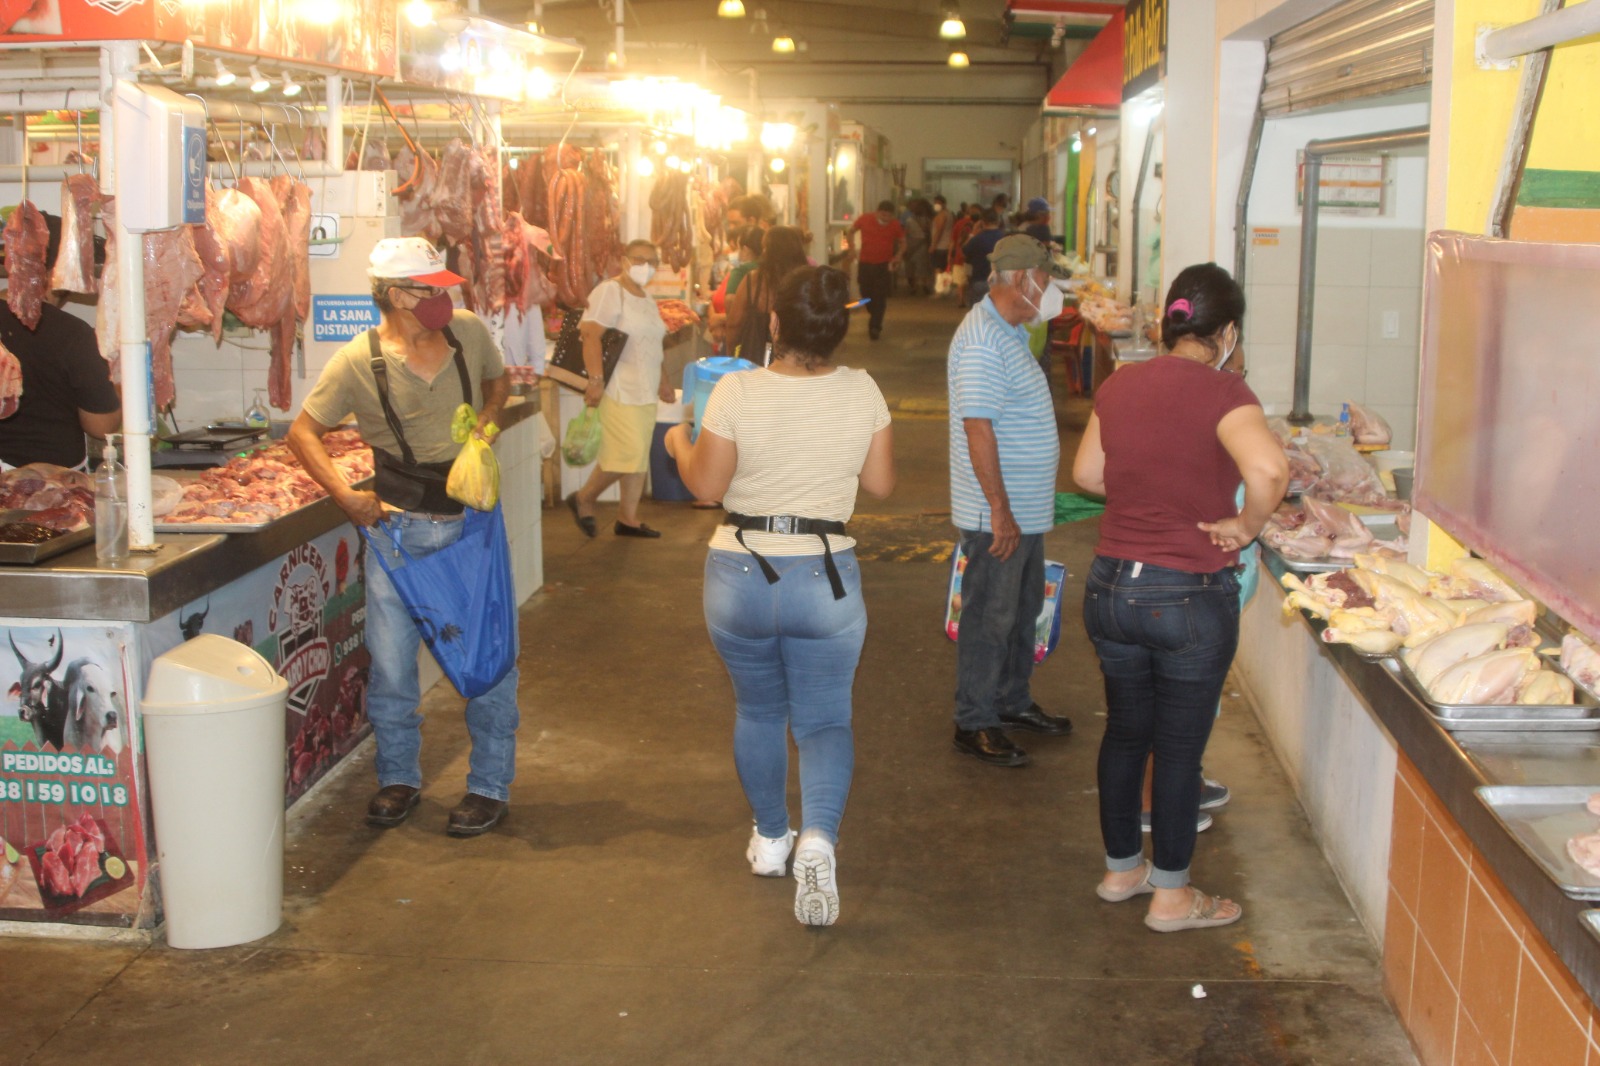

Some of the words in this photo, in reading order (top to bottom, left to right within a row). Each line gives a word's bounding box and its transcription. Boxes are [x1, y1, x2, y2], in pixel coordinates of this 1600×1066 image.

[323, 310, 338, 321] LA
[340, 310, 373, 321] SANA
[302, 651, 308, 678] Y
[3, 753, 83, 774] PEDIDOS
[85, 757, 114, 775] AL:
